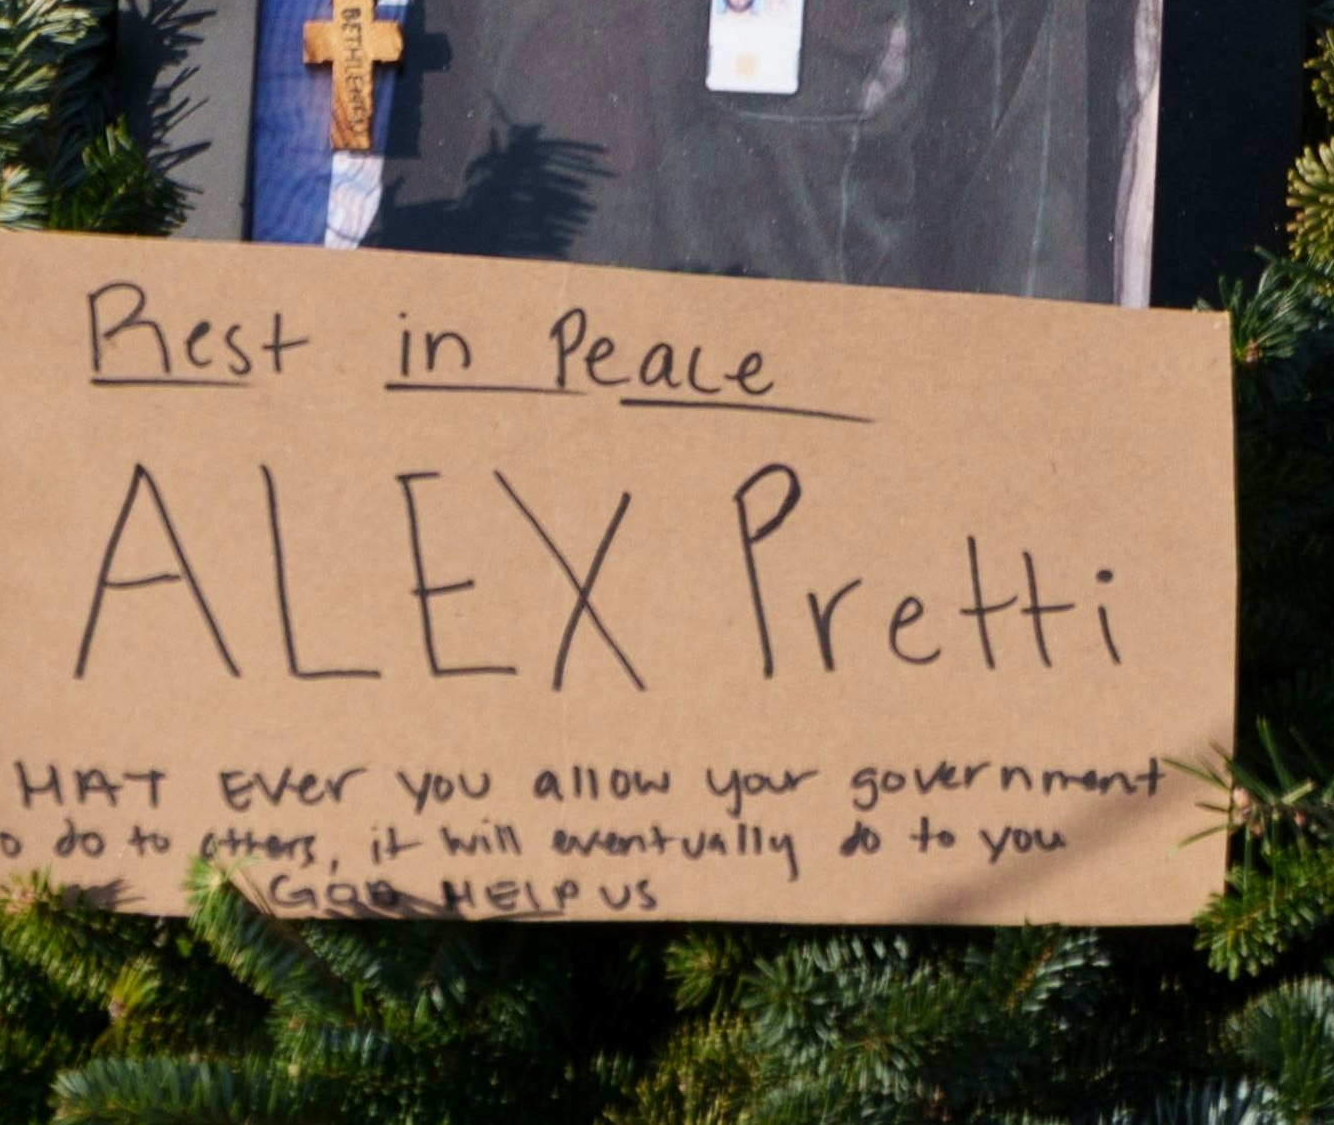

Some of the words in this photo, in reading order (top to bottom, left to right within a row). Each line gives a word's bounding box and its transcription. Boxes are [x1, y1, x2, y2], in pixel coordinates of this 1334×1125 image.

[88, 281, 310, 375] Rest
[400, 312, 471, 375] in
[549, 307, 775, 397] Peace
[74, 463, 647, 693] ALEX
[733, 463, 1121, 679] Pretti
[532, 764, 671, 803] allow
[705, 766, 818, 818] your
[54, 818, 106, 857] do
[130, 825, 172, 857] to
[369, 825, 423, 865] it
[439, 819, 522, 857] will
[838, 820, 881, 857] do
[909, 816, 956, 853] to
[979, 825, 1069, 864] you
[440, 878, 580, 912] HELP
[600, 880, 658, 911] US
